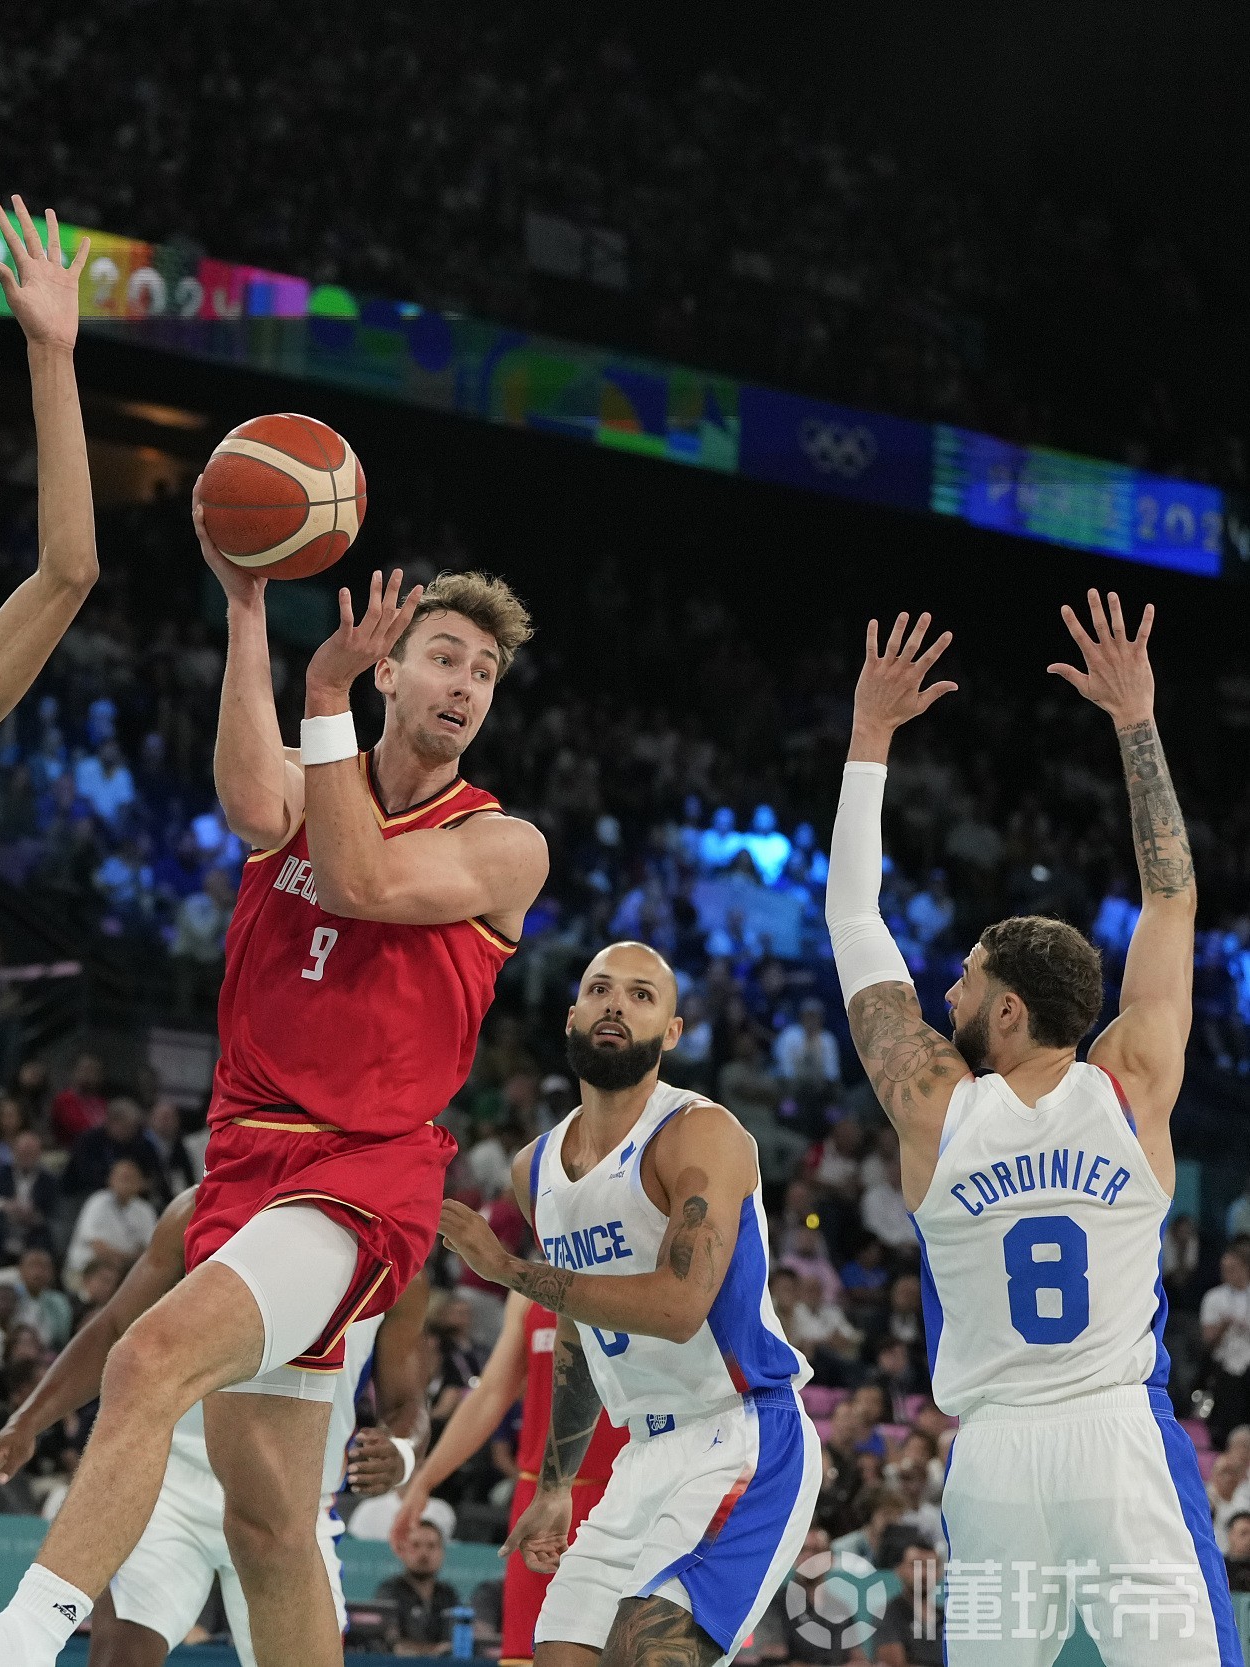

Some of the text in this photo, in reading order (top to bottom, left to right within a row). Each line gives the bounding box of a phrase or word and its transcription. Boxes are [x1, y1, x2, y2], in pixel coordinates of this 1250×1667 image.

[301, 926, 338, 981] 9
[950, 1148, 1131, 1217] CORDINIER
[1003, 1215, 1090, 1344] 8
